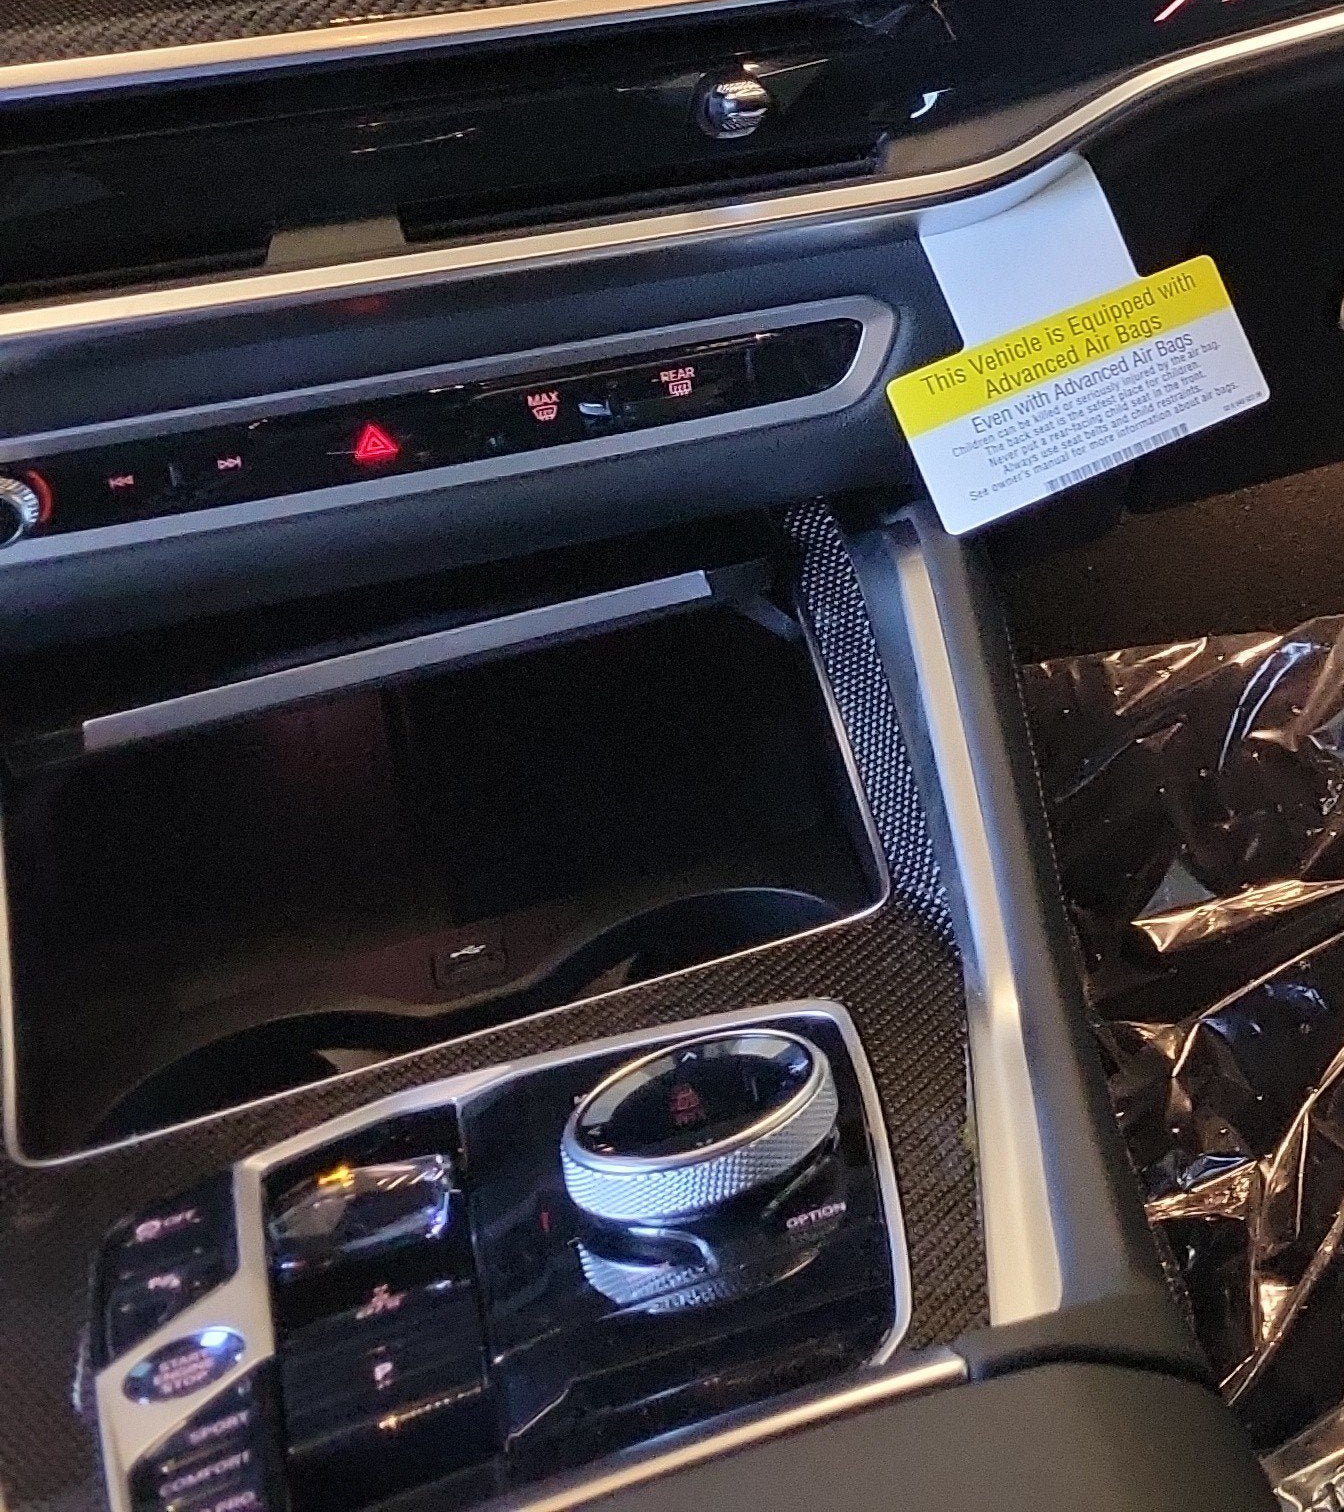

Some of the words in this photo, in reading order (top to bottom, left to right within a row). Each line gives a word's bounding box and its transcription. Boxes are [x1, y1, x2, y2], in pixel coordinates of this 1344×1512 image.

[660, 366, 696, 383] REAR
[919, 367, 967, 395] This
[967, 336, 1042, 375] Vehicle
[1044, 327, 1065, 346] is
[1066, 286, 1156, 336] Equipped
[1157, 272, 1197, 299] with
[986, 345, 1080, 399] Advanced
[1085, 334, 1110, 358] Air
[1114, 315, 1162, 344] Bags
[527, 390, 560, 407] MAX
[952, 434, 995, 457] Children
[998, 425, 1017, 438] can
[1017, 419, 1031, 429] be
[1032, 405, 1060, 423] killed
[1063, 401, 1073, 411] or
[1075, 382, 1120, 405] seriously
[1122, 366, 1156, 385] injured
[1156, 361, 1169, 371] by
[1170, 354, 1186, 365] the
[1187, 348, 1199, 359] air
[971, 408, 1013, 434] Even
[1014, 391, 1051, 415] with
[1054, 356, 1130, 400] Advanced
[1132, 348, 1153, 368] Air
[1154, 333, 1193, 357] Bags
[984, 443, 1004, 455] The
[1006, 432, 1032, 447] back
[1033, 421, 1055, 436] seat
[1056, 417, 1066, 425] is
[1067, 409, 1085, 421] the
[1086, 395, 1117, 414] safest
[1118, 384, 1144, 401] place
[1145, 377, 1159, 388] for
[988, 449, 1018, 467] Never
[1021, 440, 1039, 455] put
[1049, 414, 1103, 441] rear-facing
[1105, 401, 1129, 418] child
[1130, 392, 1152, 407] seat
[1153, 388, 1162, 397] in
[1163, 382, 1179, 393] the
[969, 488, 989, 501] See
[991, 470, 1031, 492] owner's
[1033, 451, 1070, 474] manual
[1071, 445, 1086, 457] for
[1089, 434, 1114, 449] more
[1117, 409, 1172, 438] information
[1174, 397, 1201, 414] about
[1201, 391, 1213, 402] air
[1003, 454, 1039, 474] Always
[1041, 445, 1059, 458] use
[1061, 434, 1084, 449] seat
[1083, 424, 1109, 439] belts
[1111, 414, 1129, 428] and
[1131, 403, 1155, 419] child
[787, 1202, 846, 1230] OPTION
